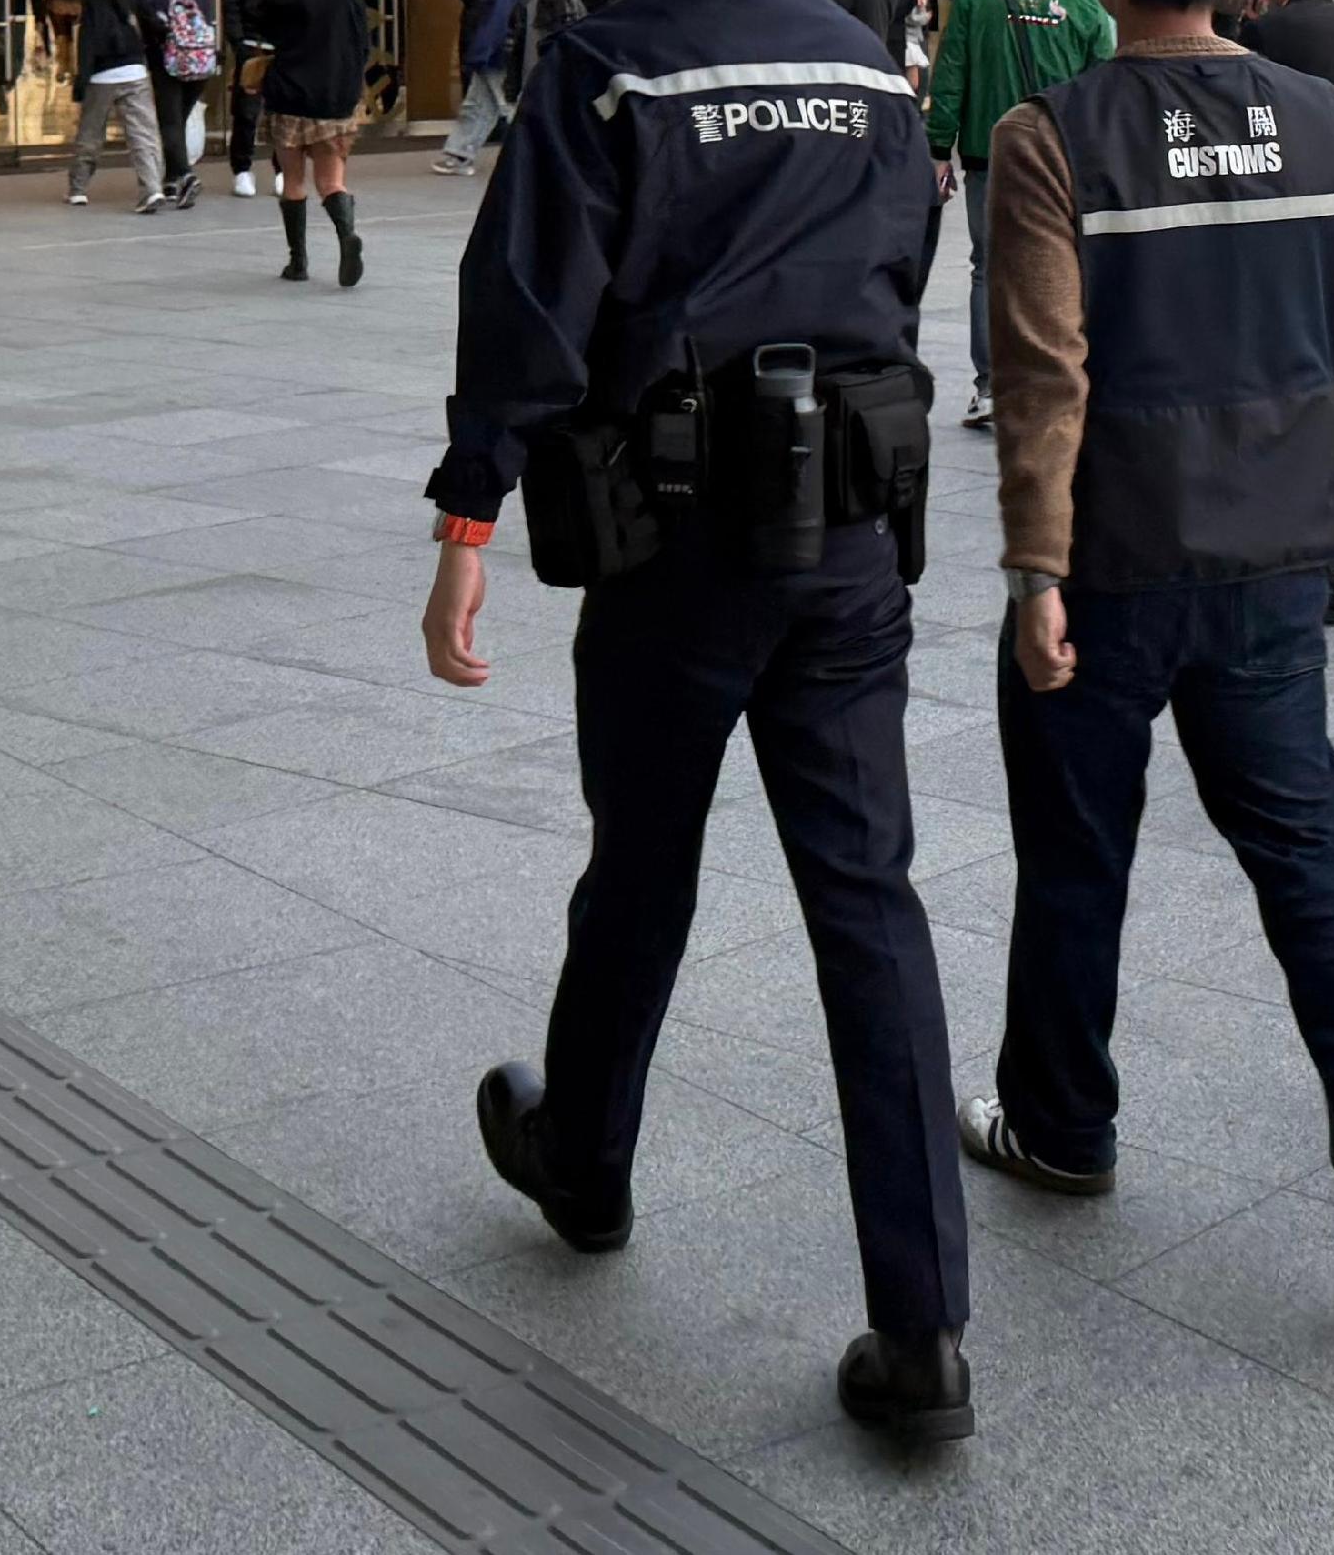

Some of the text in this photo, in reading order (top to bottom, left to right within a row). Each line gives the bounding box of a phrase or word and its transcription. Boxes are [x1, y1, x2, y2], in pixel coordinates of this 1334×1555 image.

[690, 103, 724, 144] 警
[723, 97, 849, 138] POLICE
[1162, 105, 1278, 143] 海關
[1167, 141, 1283, 178] CUSTOMS
